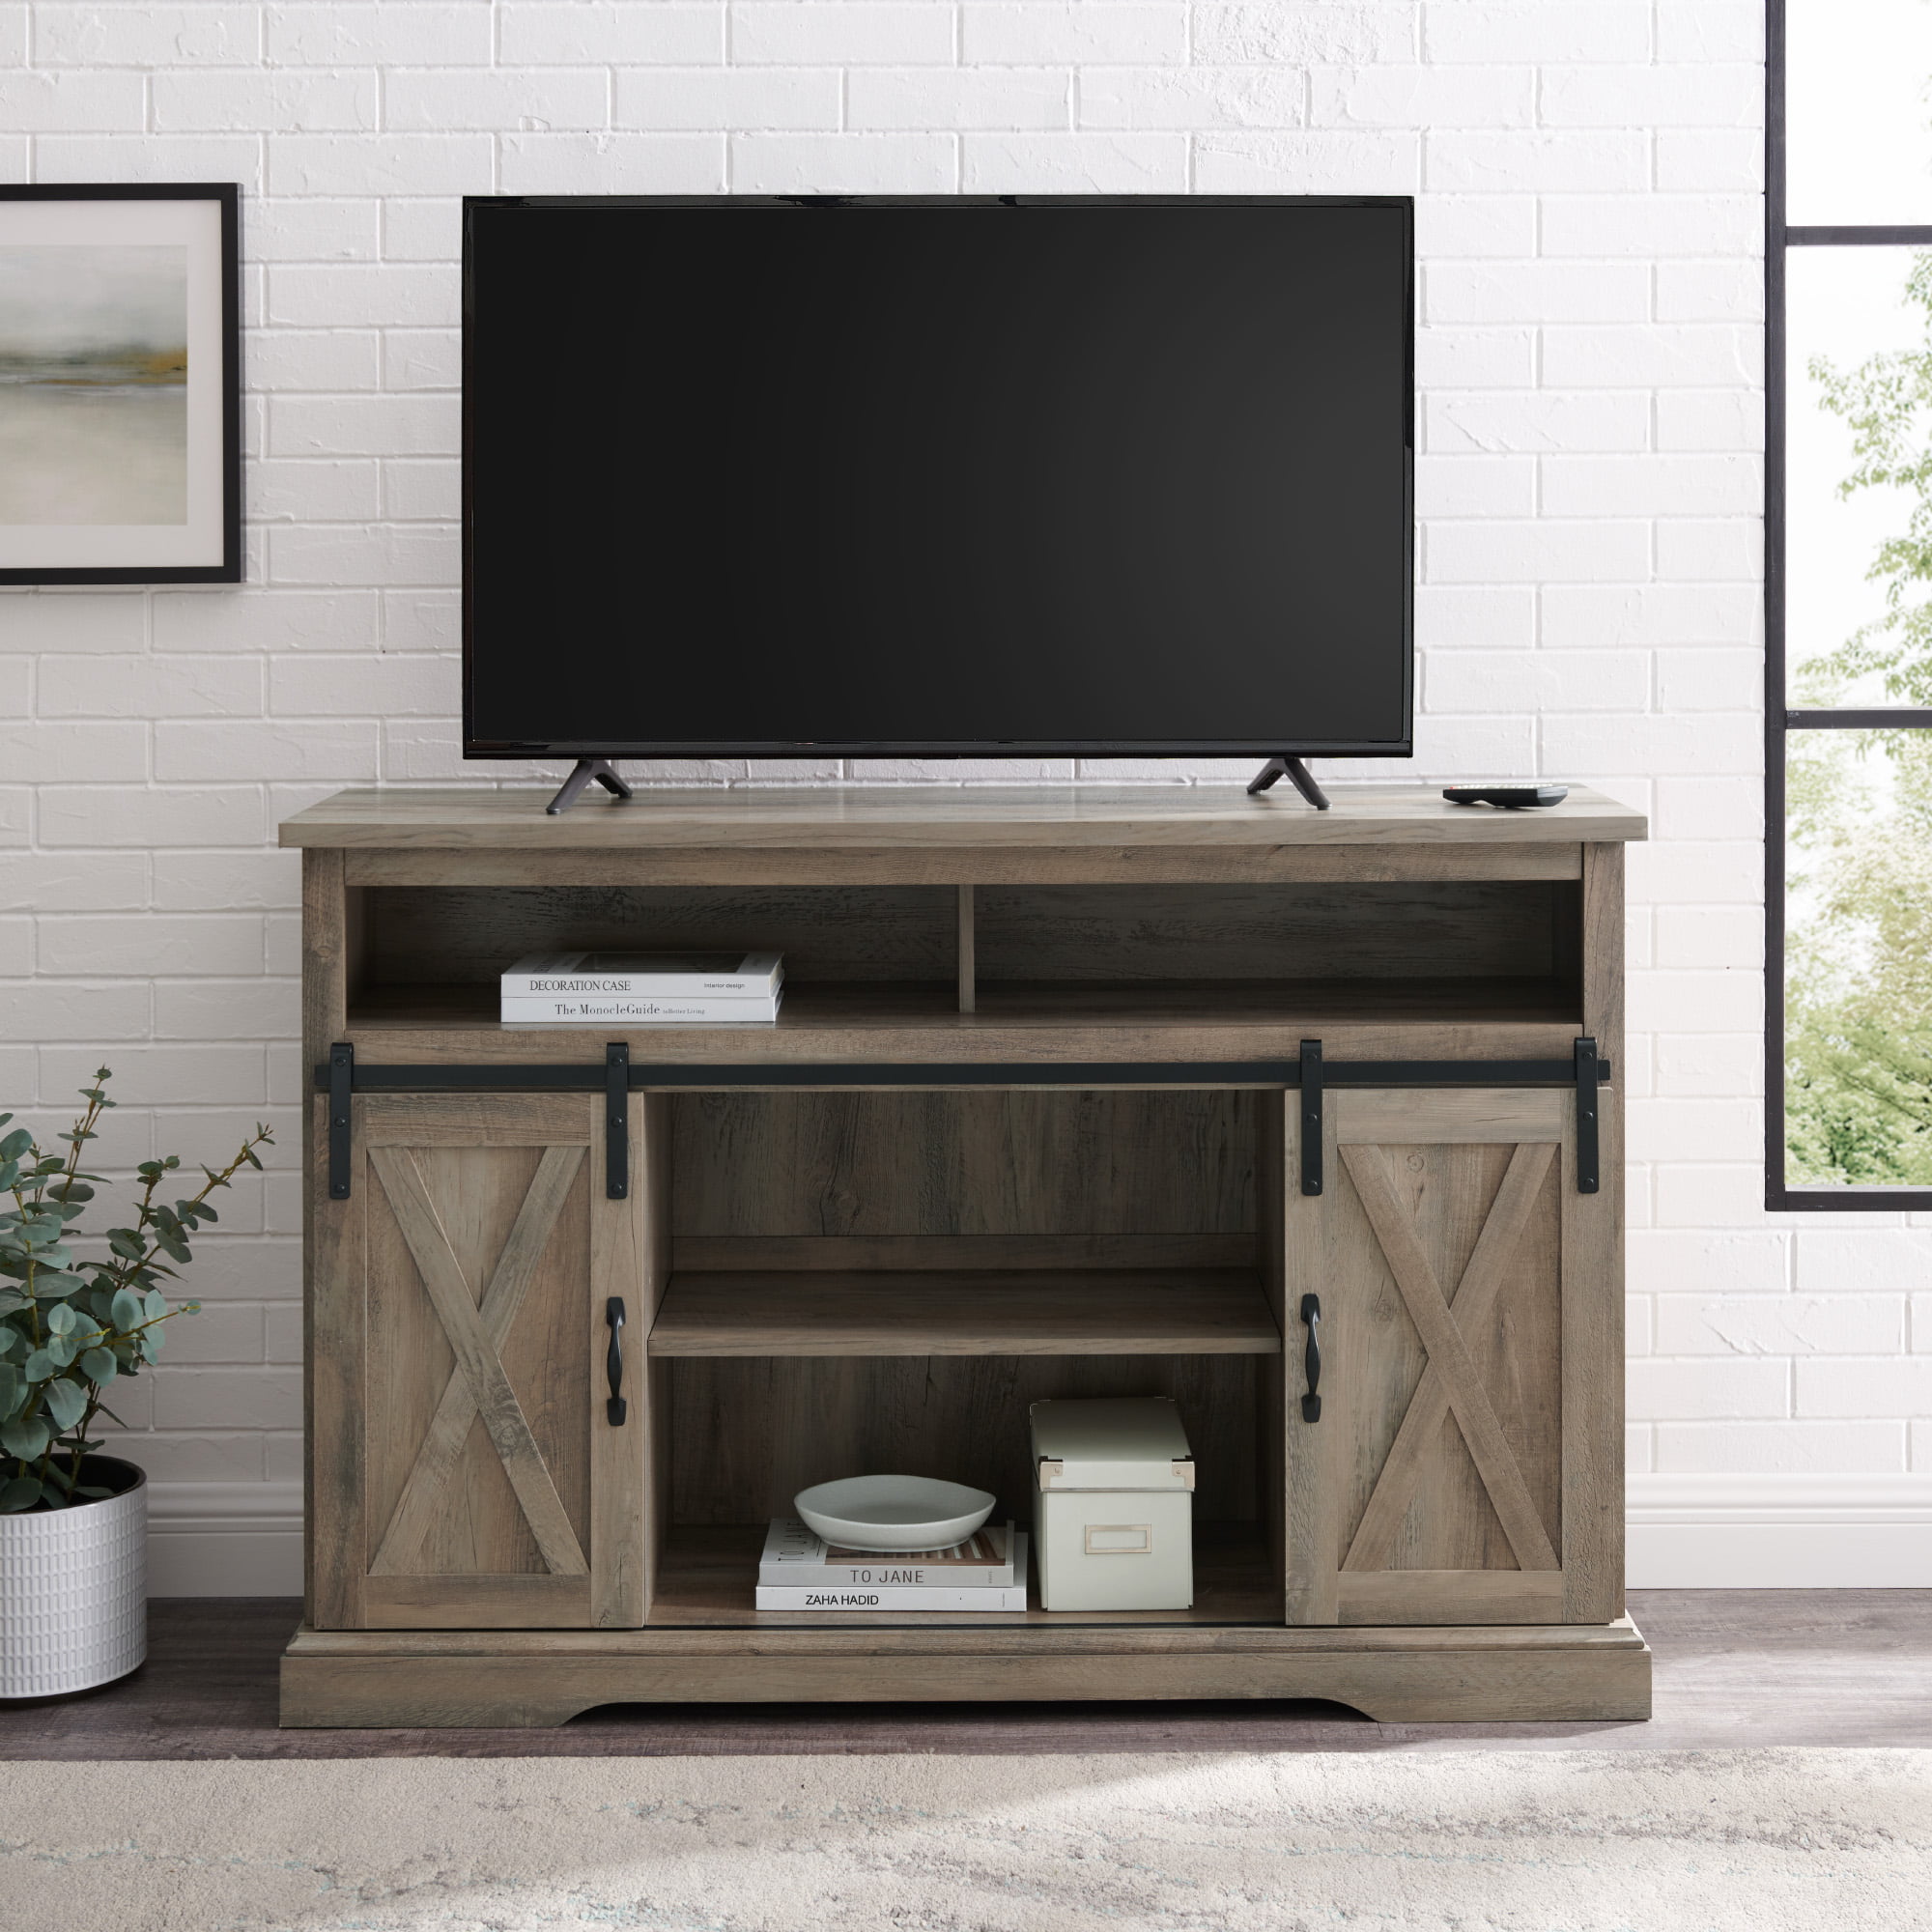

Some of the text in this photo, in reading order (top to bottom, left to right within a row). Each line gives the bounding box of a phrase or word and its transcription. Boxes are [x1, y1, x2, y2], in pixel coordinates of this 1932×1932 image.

[529, 980, 632, 991] DECORATION CASE
[554, 1004, 577, 1015] The
[850, 1570, 924, 1583] TO JANE
[805, 1594, 879, 1605] ZAHA HADID
